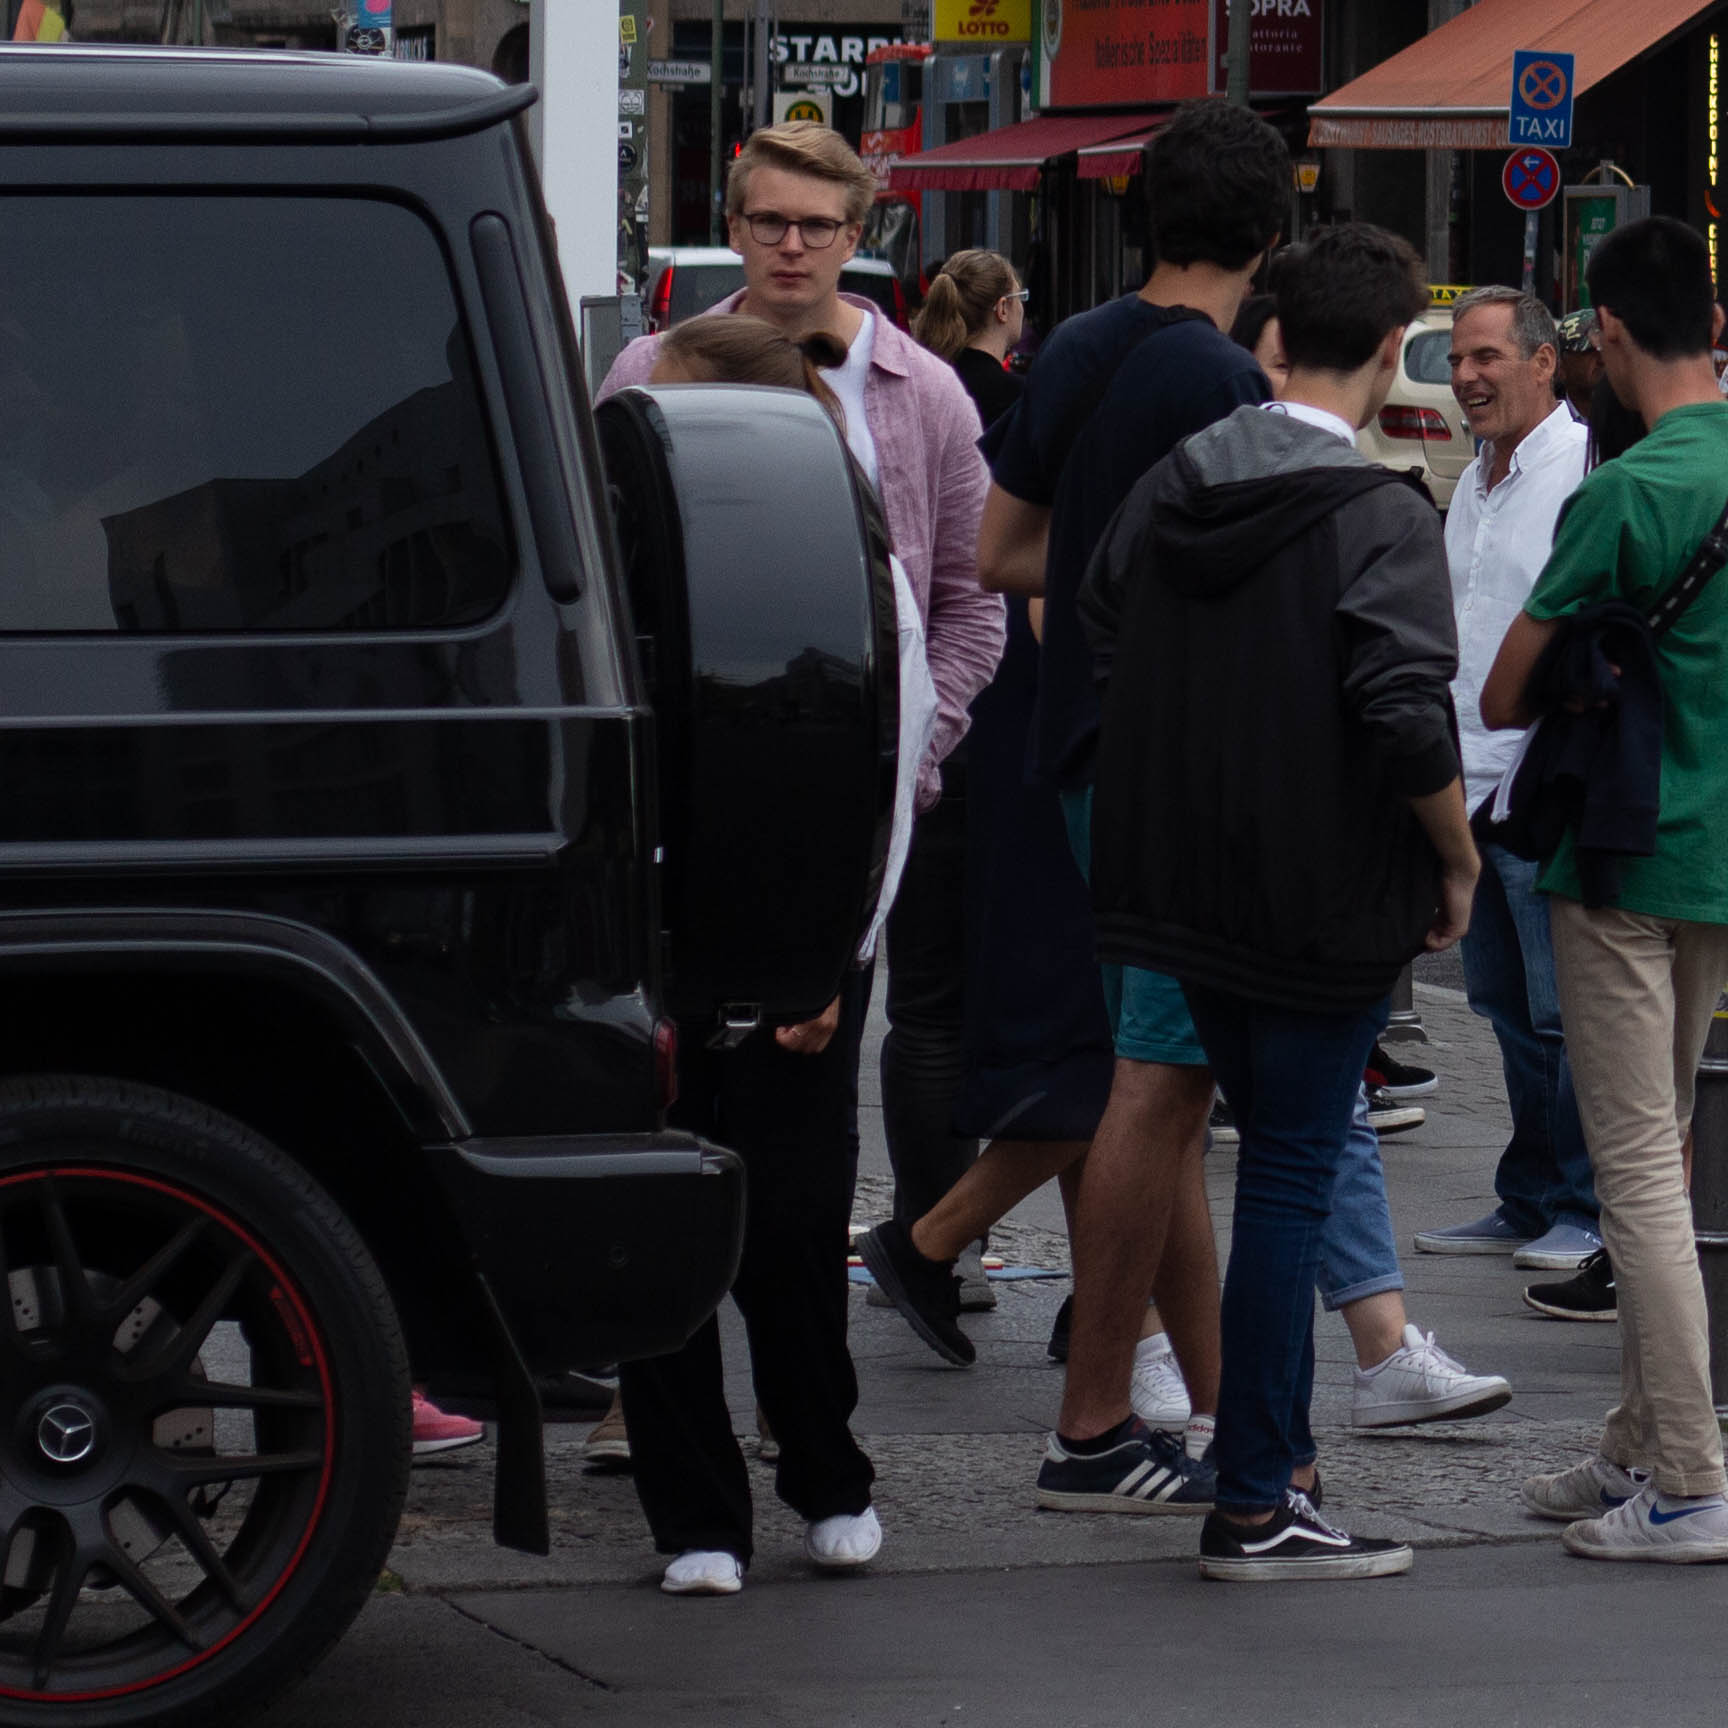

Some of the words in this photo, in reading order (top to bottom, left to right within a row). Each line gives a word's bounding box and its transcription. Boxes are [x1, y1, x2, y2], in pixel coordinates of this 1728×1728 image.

[957, 20, 1009, 37] LOTTO
[1252, 29, 1298, 39] attoria
[1708, 33, 1719, 187] CHECKPOINT
[1516, 116, 1565, 140] TAXI
[1432, 288, 1464, 300] TAX
